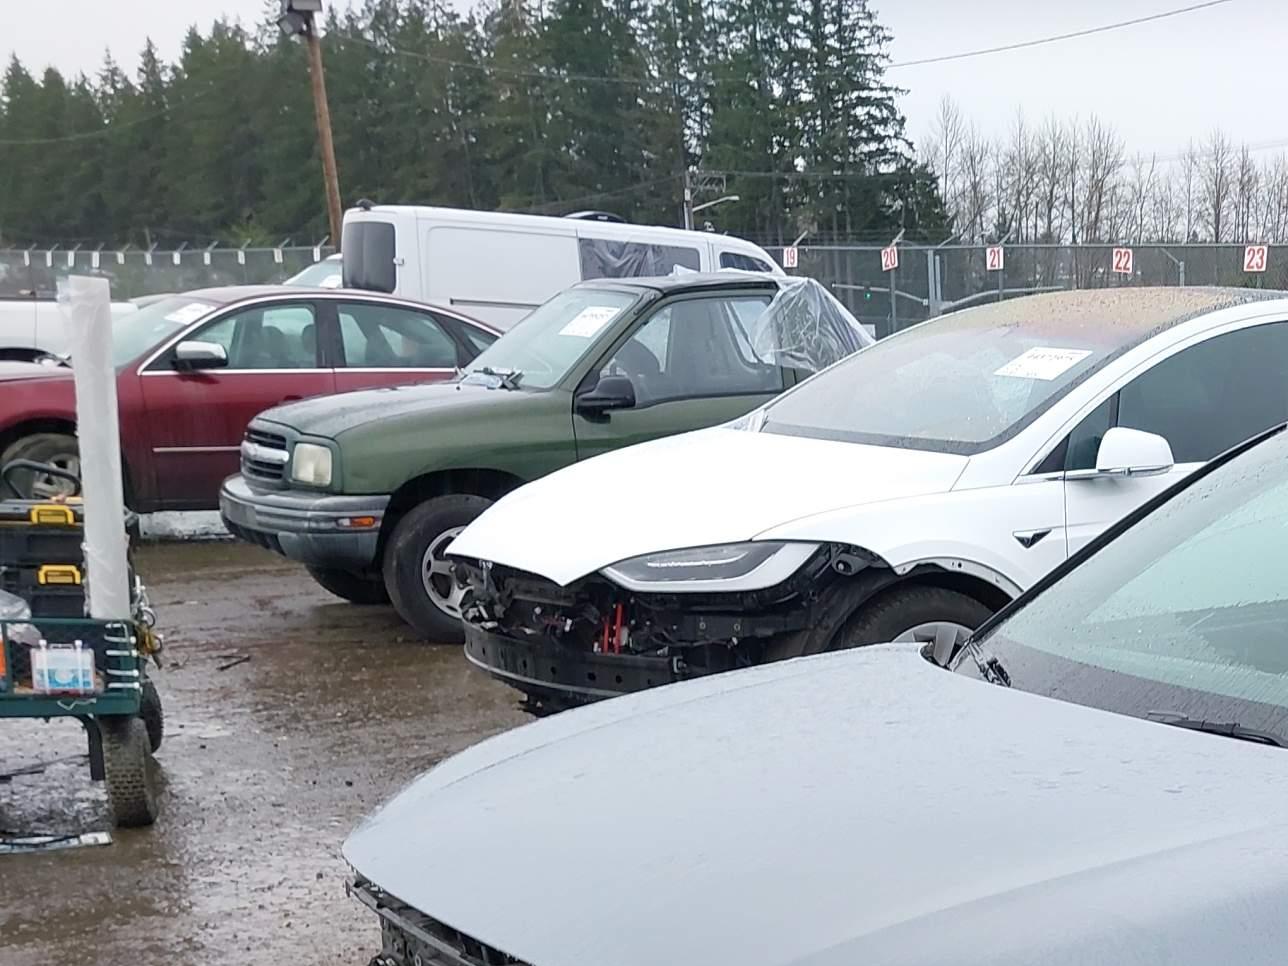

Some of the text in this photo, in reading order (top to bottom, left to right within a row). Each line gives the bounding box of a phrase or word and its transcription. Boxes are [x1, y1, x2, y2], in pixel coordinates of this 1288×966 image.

[786, 248, 796, 266] 19
[883, 247, 896, 268] 20
[989, 249, 1001, 268] 21
[1114, 250, 1131, 271] 22
[1246, 247, 1266, 269] 23
